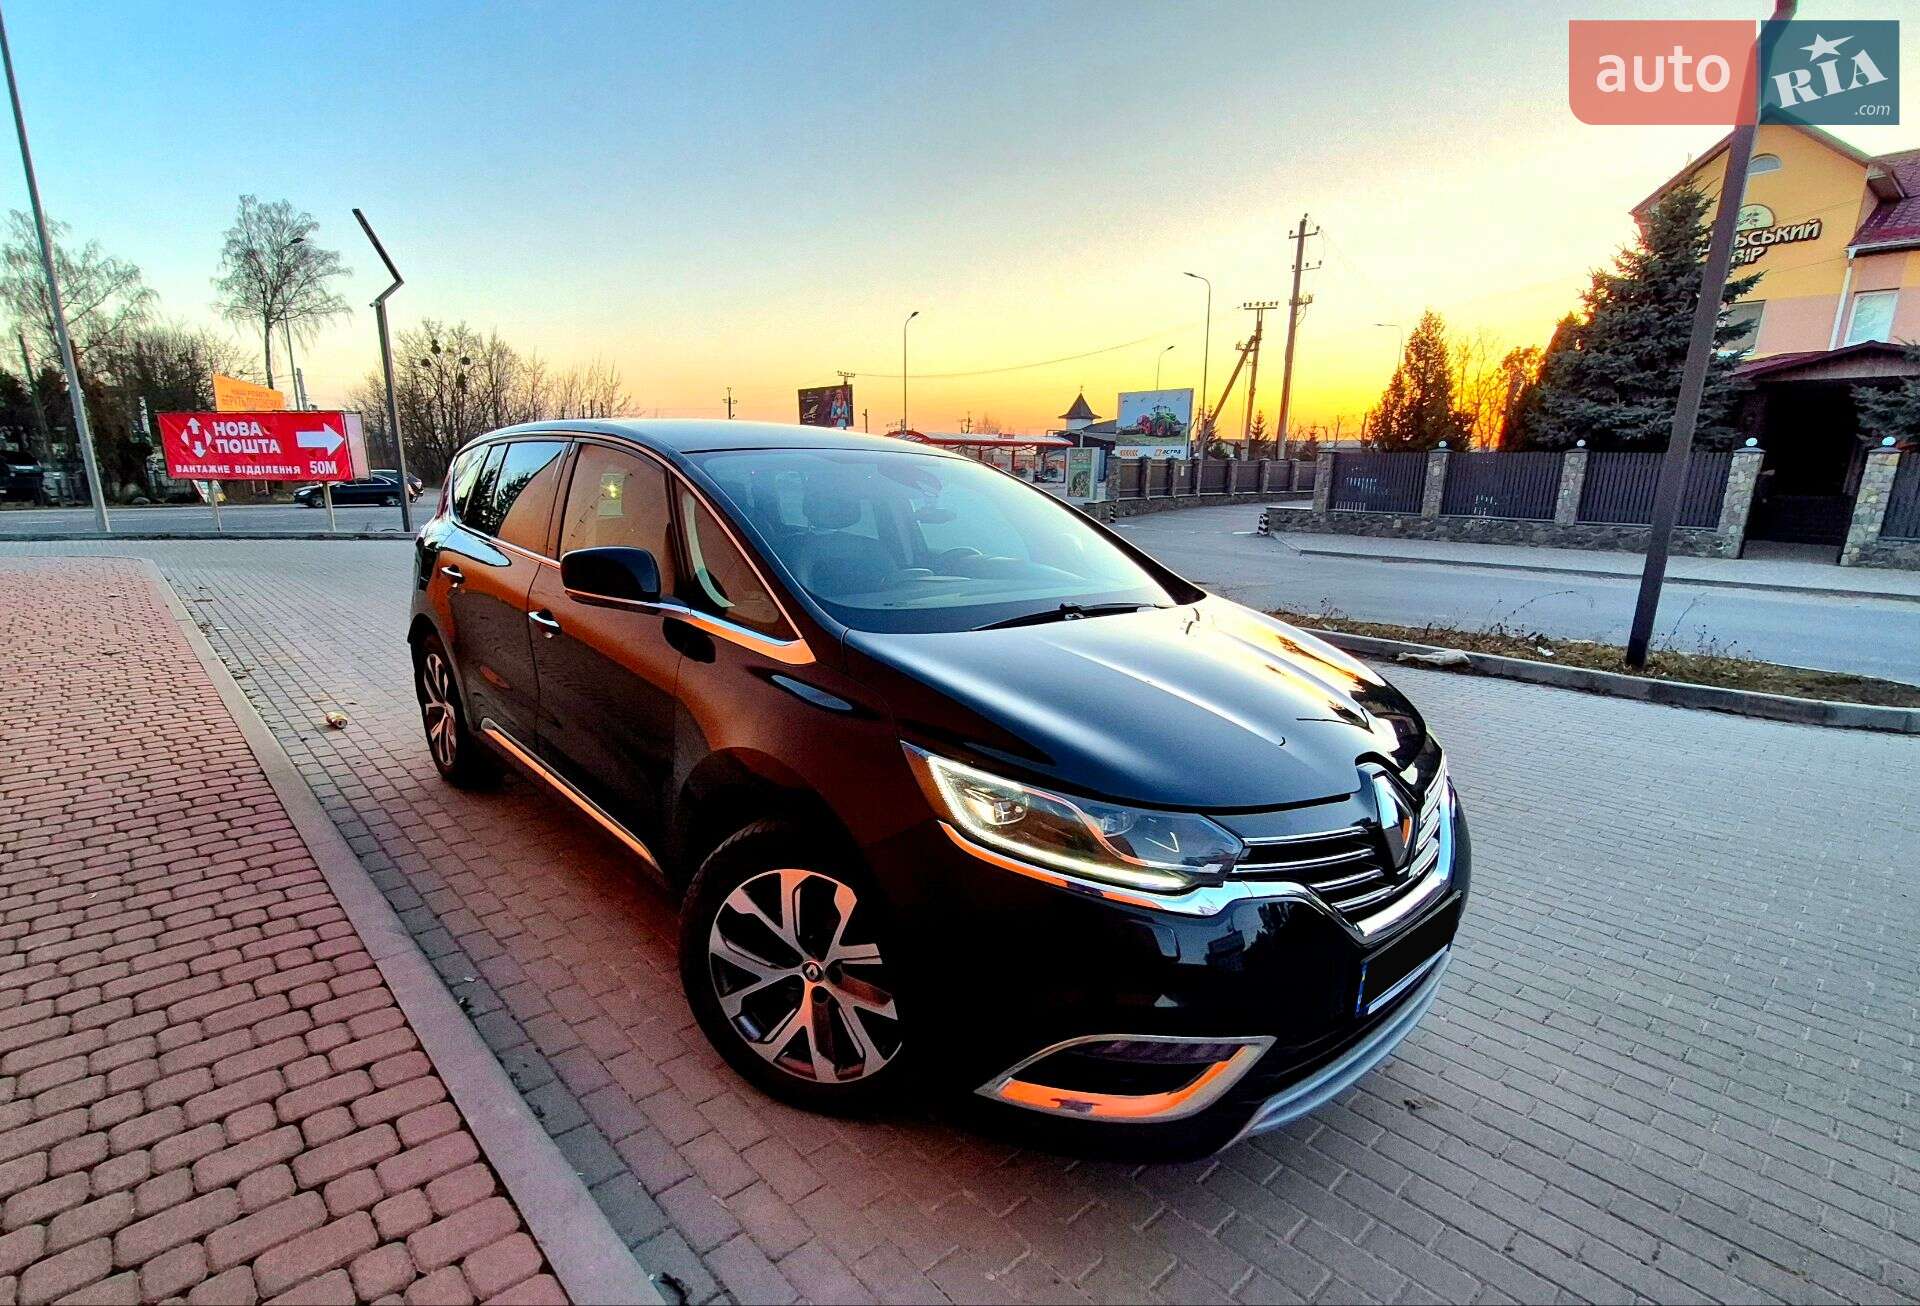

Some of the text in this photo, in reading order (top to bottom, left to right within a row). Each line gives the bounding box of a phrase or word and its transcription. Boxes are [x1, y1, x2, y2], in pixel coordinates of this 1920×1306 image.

[212, 421, 263, 437] НОВА
[215, 438, 281, 454] ПОШТА
[175, 464, 301, 475] ВАНТАЖНЕ ВІДДІЛЕННЯ
